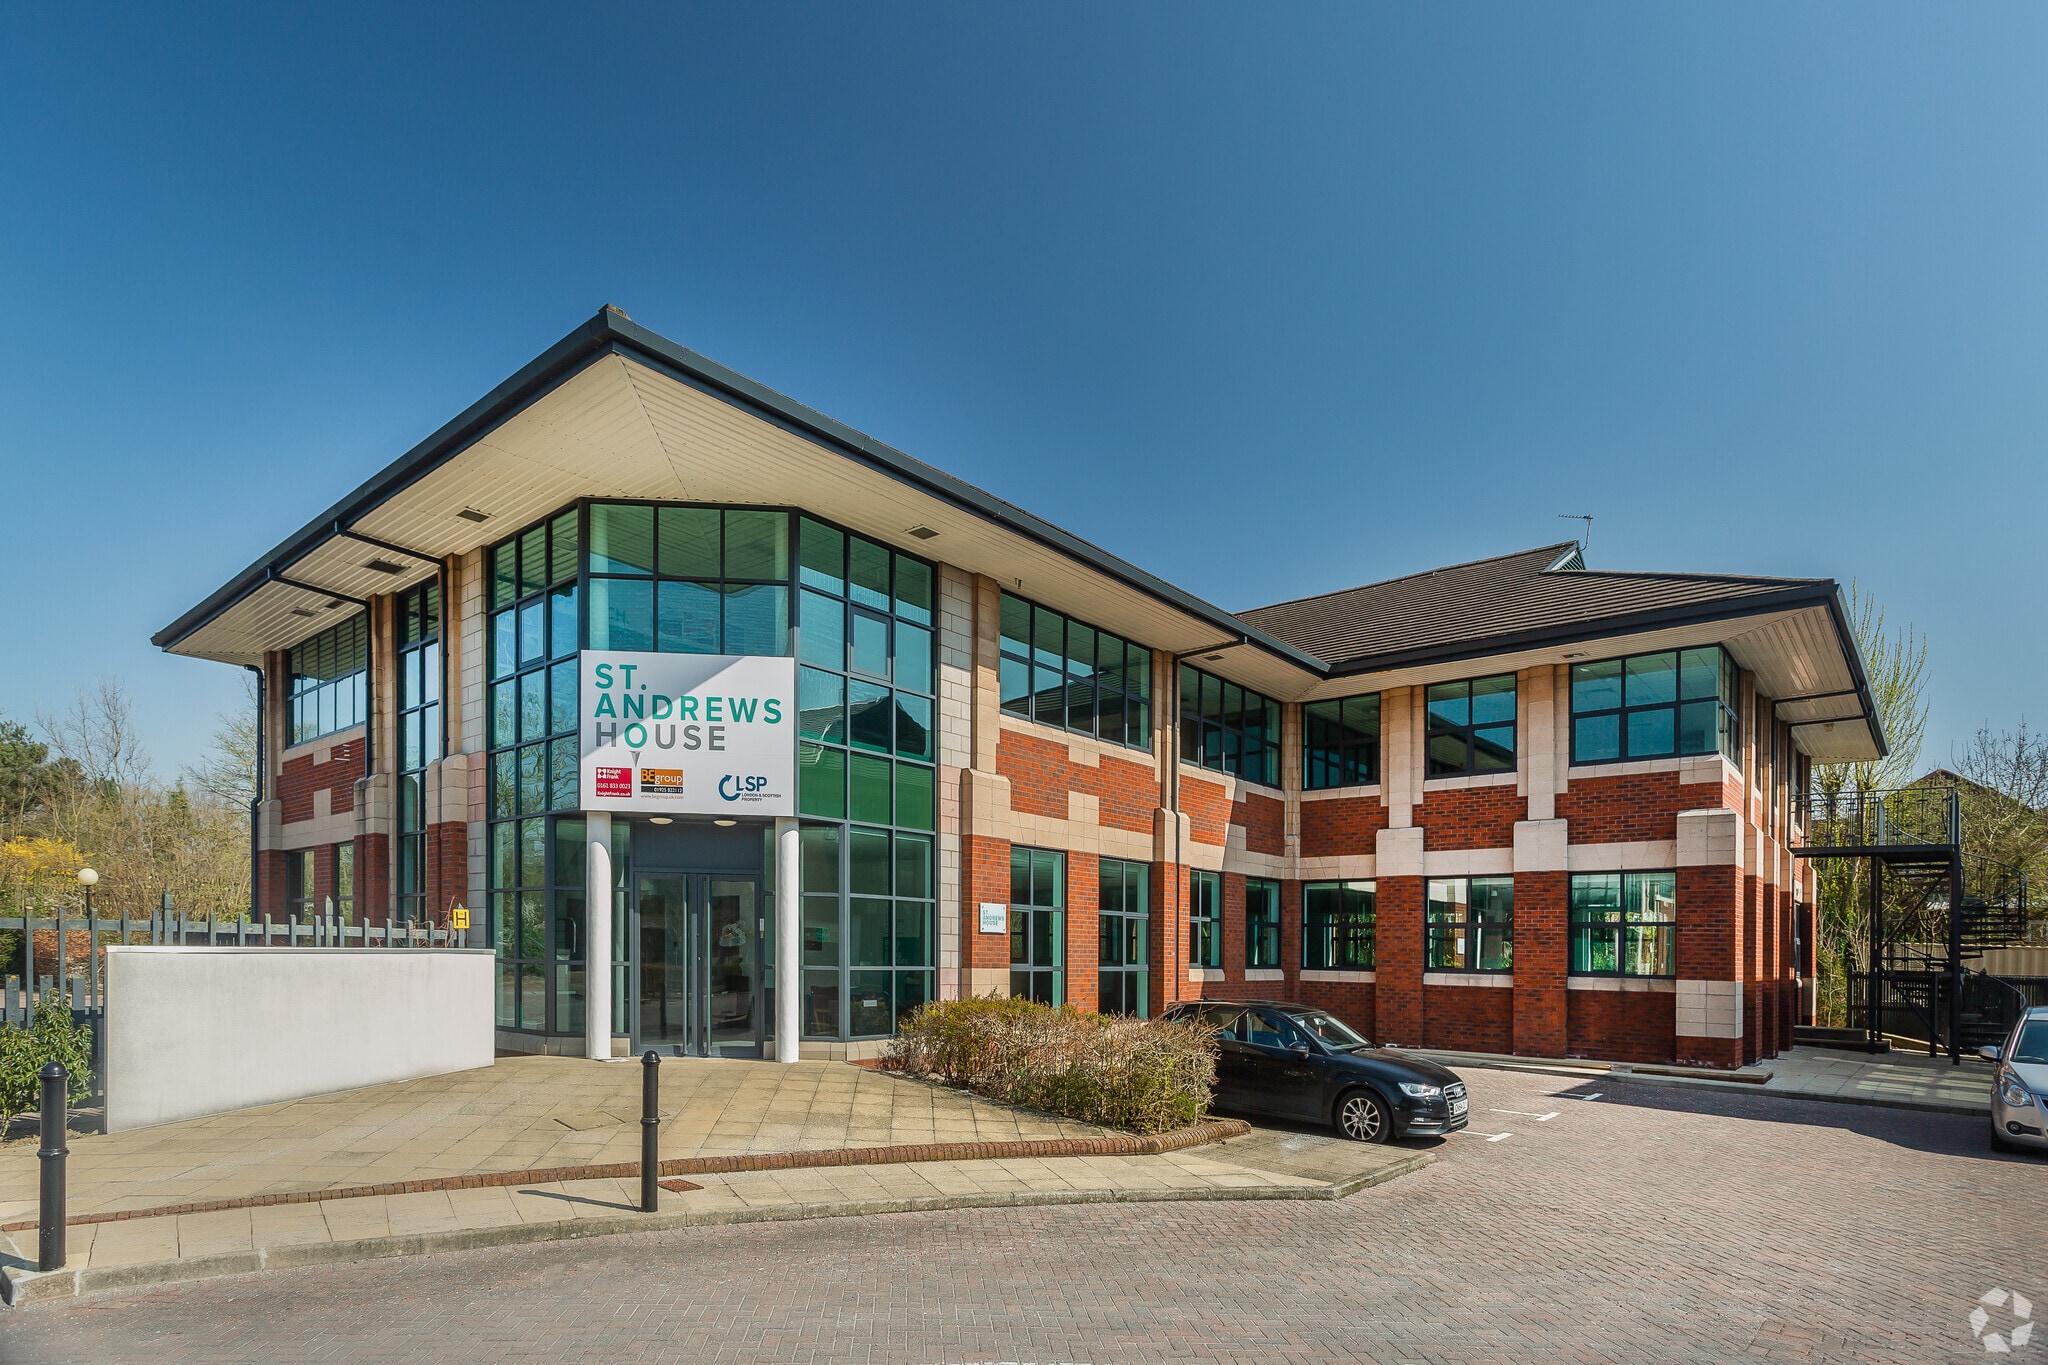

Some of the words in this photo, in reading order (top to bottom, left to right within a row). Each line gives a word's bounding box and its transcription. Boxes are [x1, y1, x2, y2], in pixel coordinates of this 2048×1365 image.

[594, 663, 647, 691] ST.
[594, 692, 782, 724] ANDREWS
[595, 721, 726, 751] HOUSE
[456, 911, 467, 927] H
